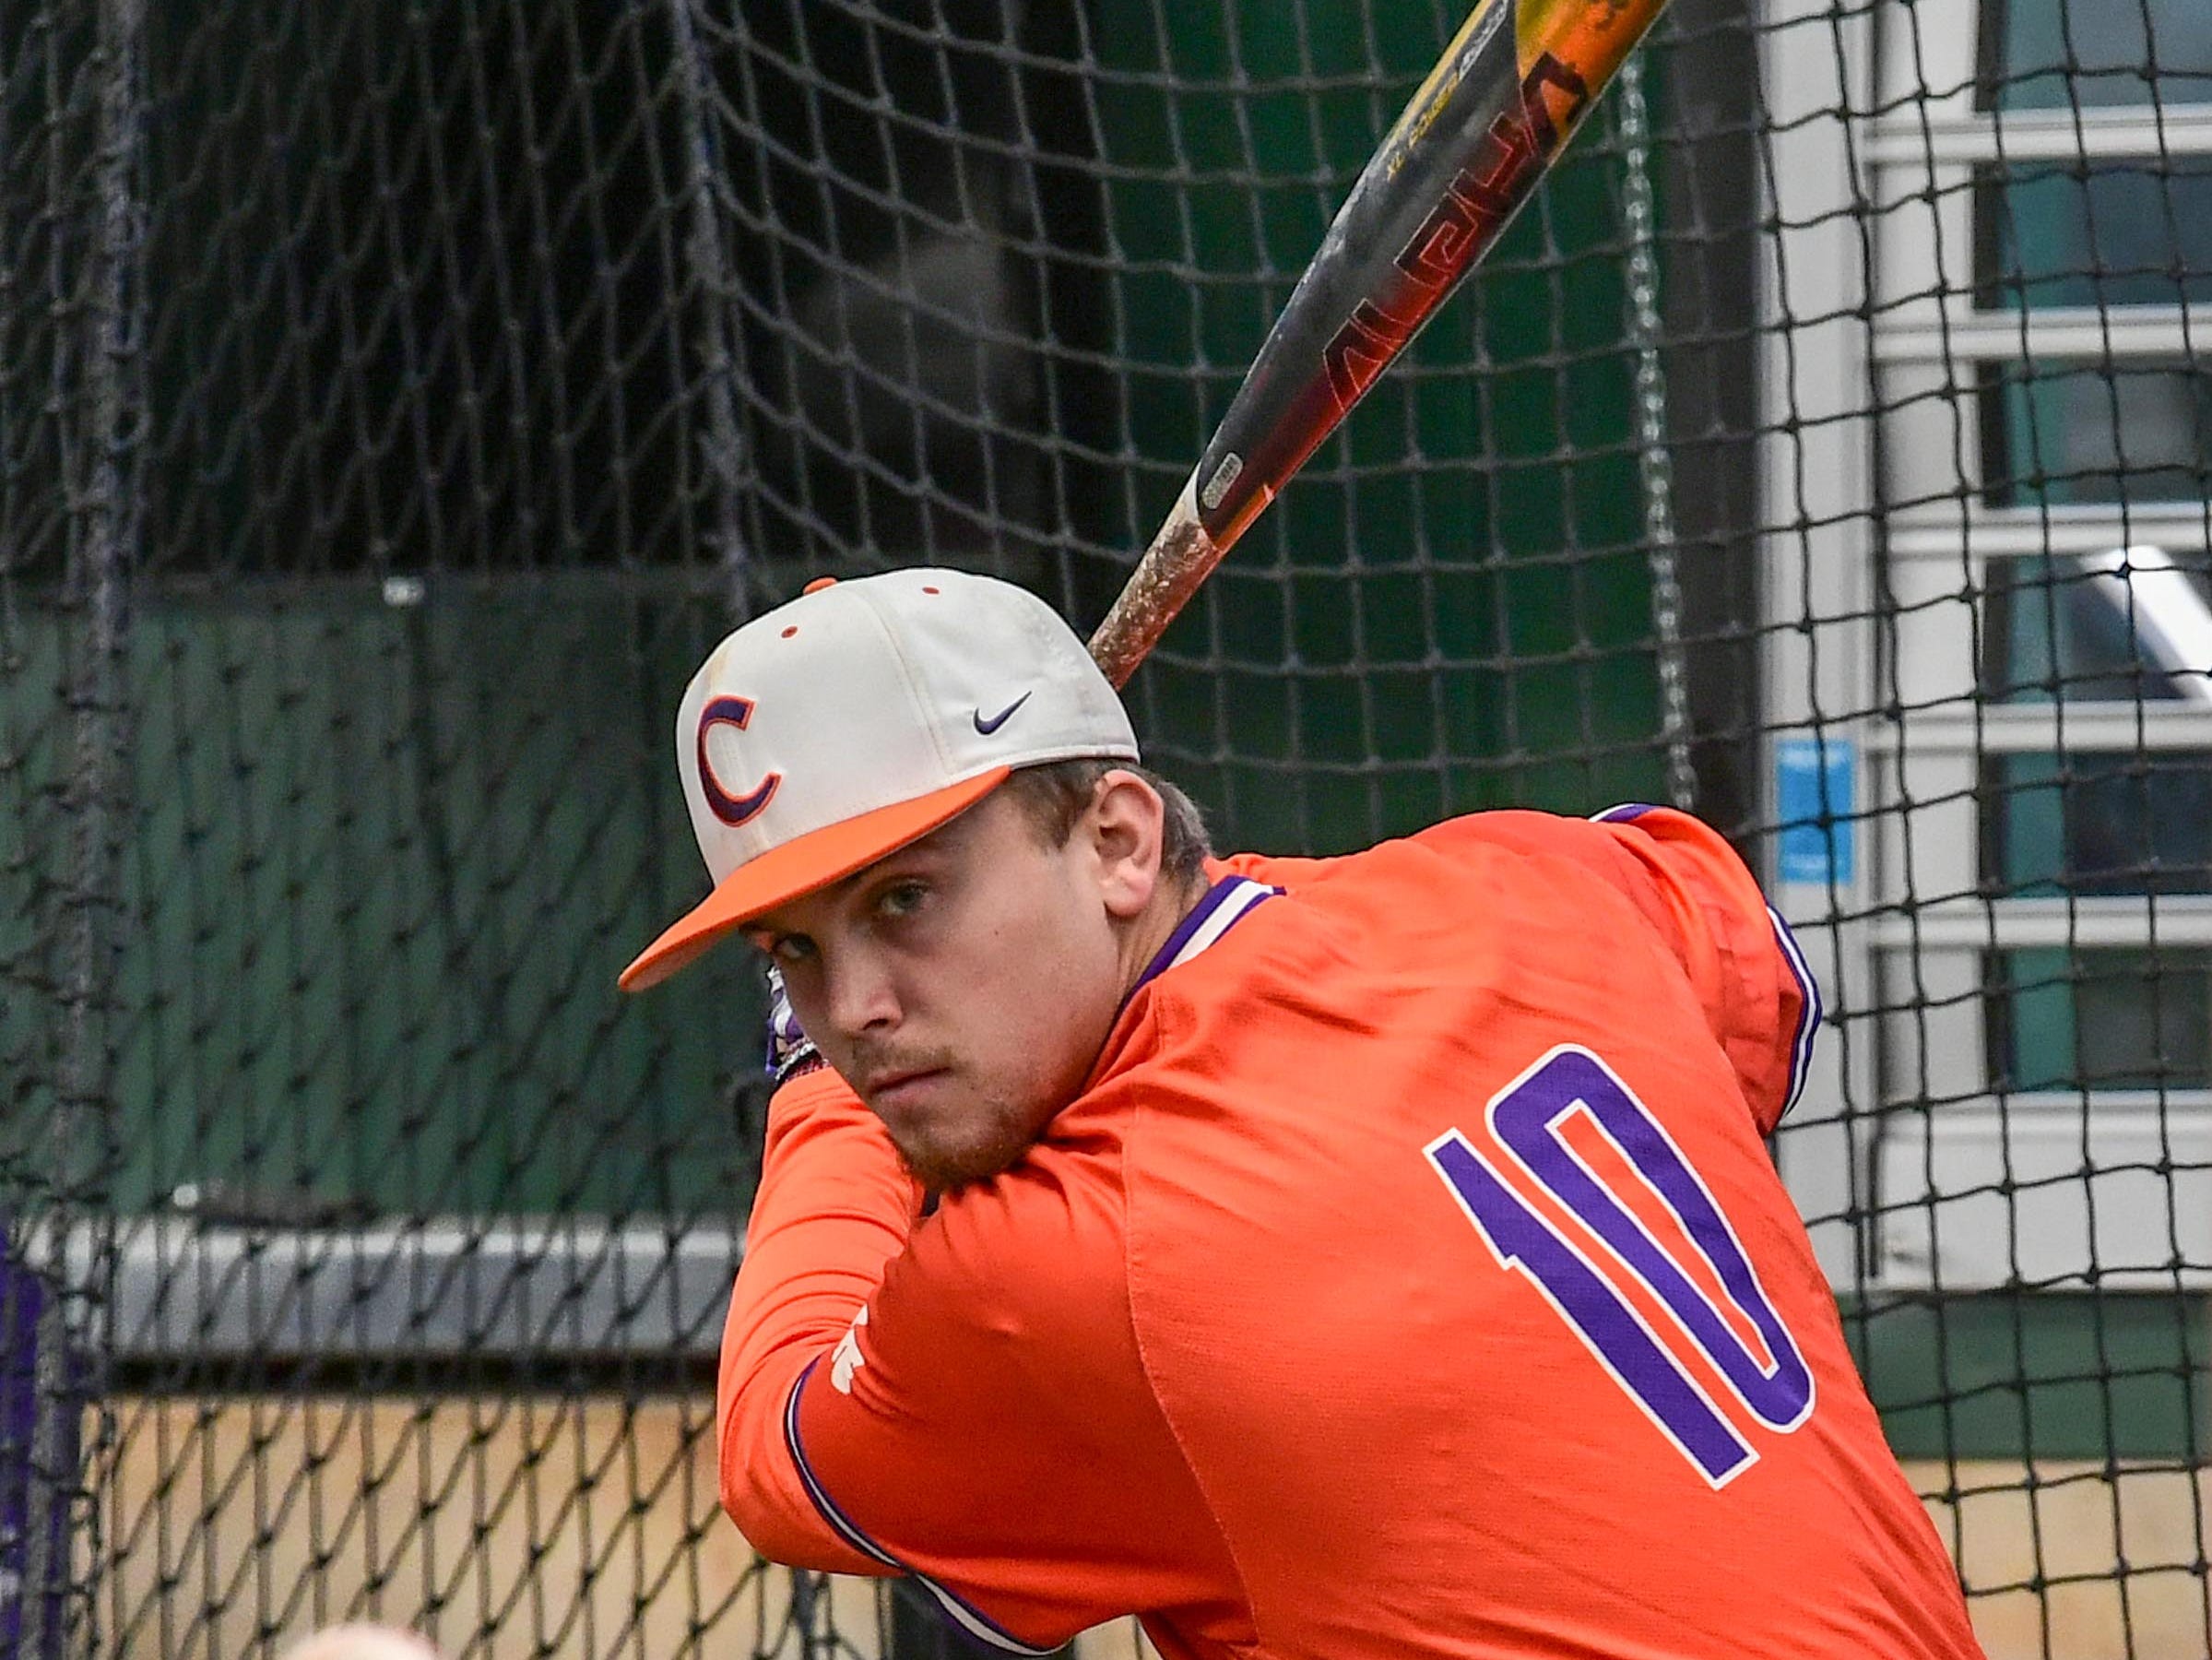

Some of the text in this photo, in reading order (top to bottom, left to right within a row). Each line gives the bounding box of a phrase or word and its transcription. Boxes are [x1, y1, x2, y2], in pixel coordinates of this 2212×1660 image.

[1323, 51, 1588, 414] ALPHA
[696, 694, 782, 827] C
[1422, 1042, 1816, 1491] 10
